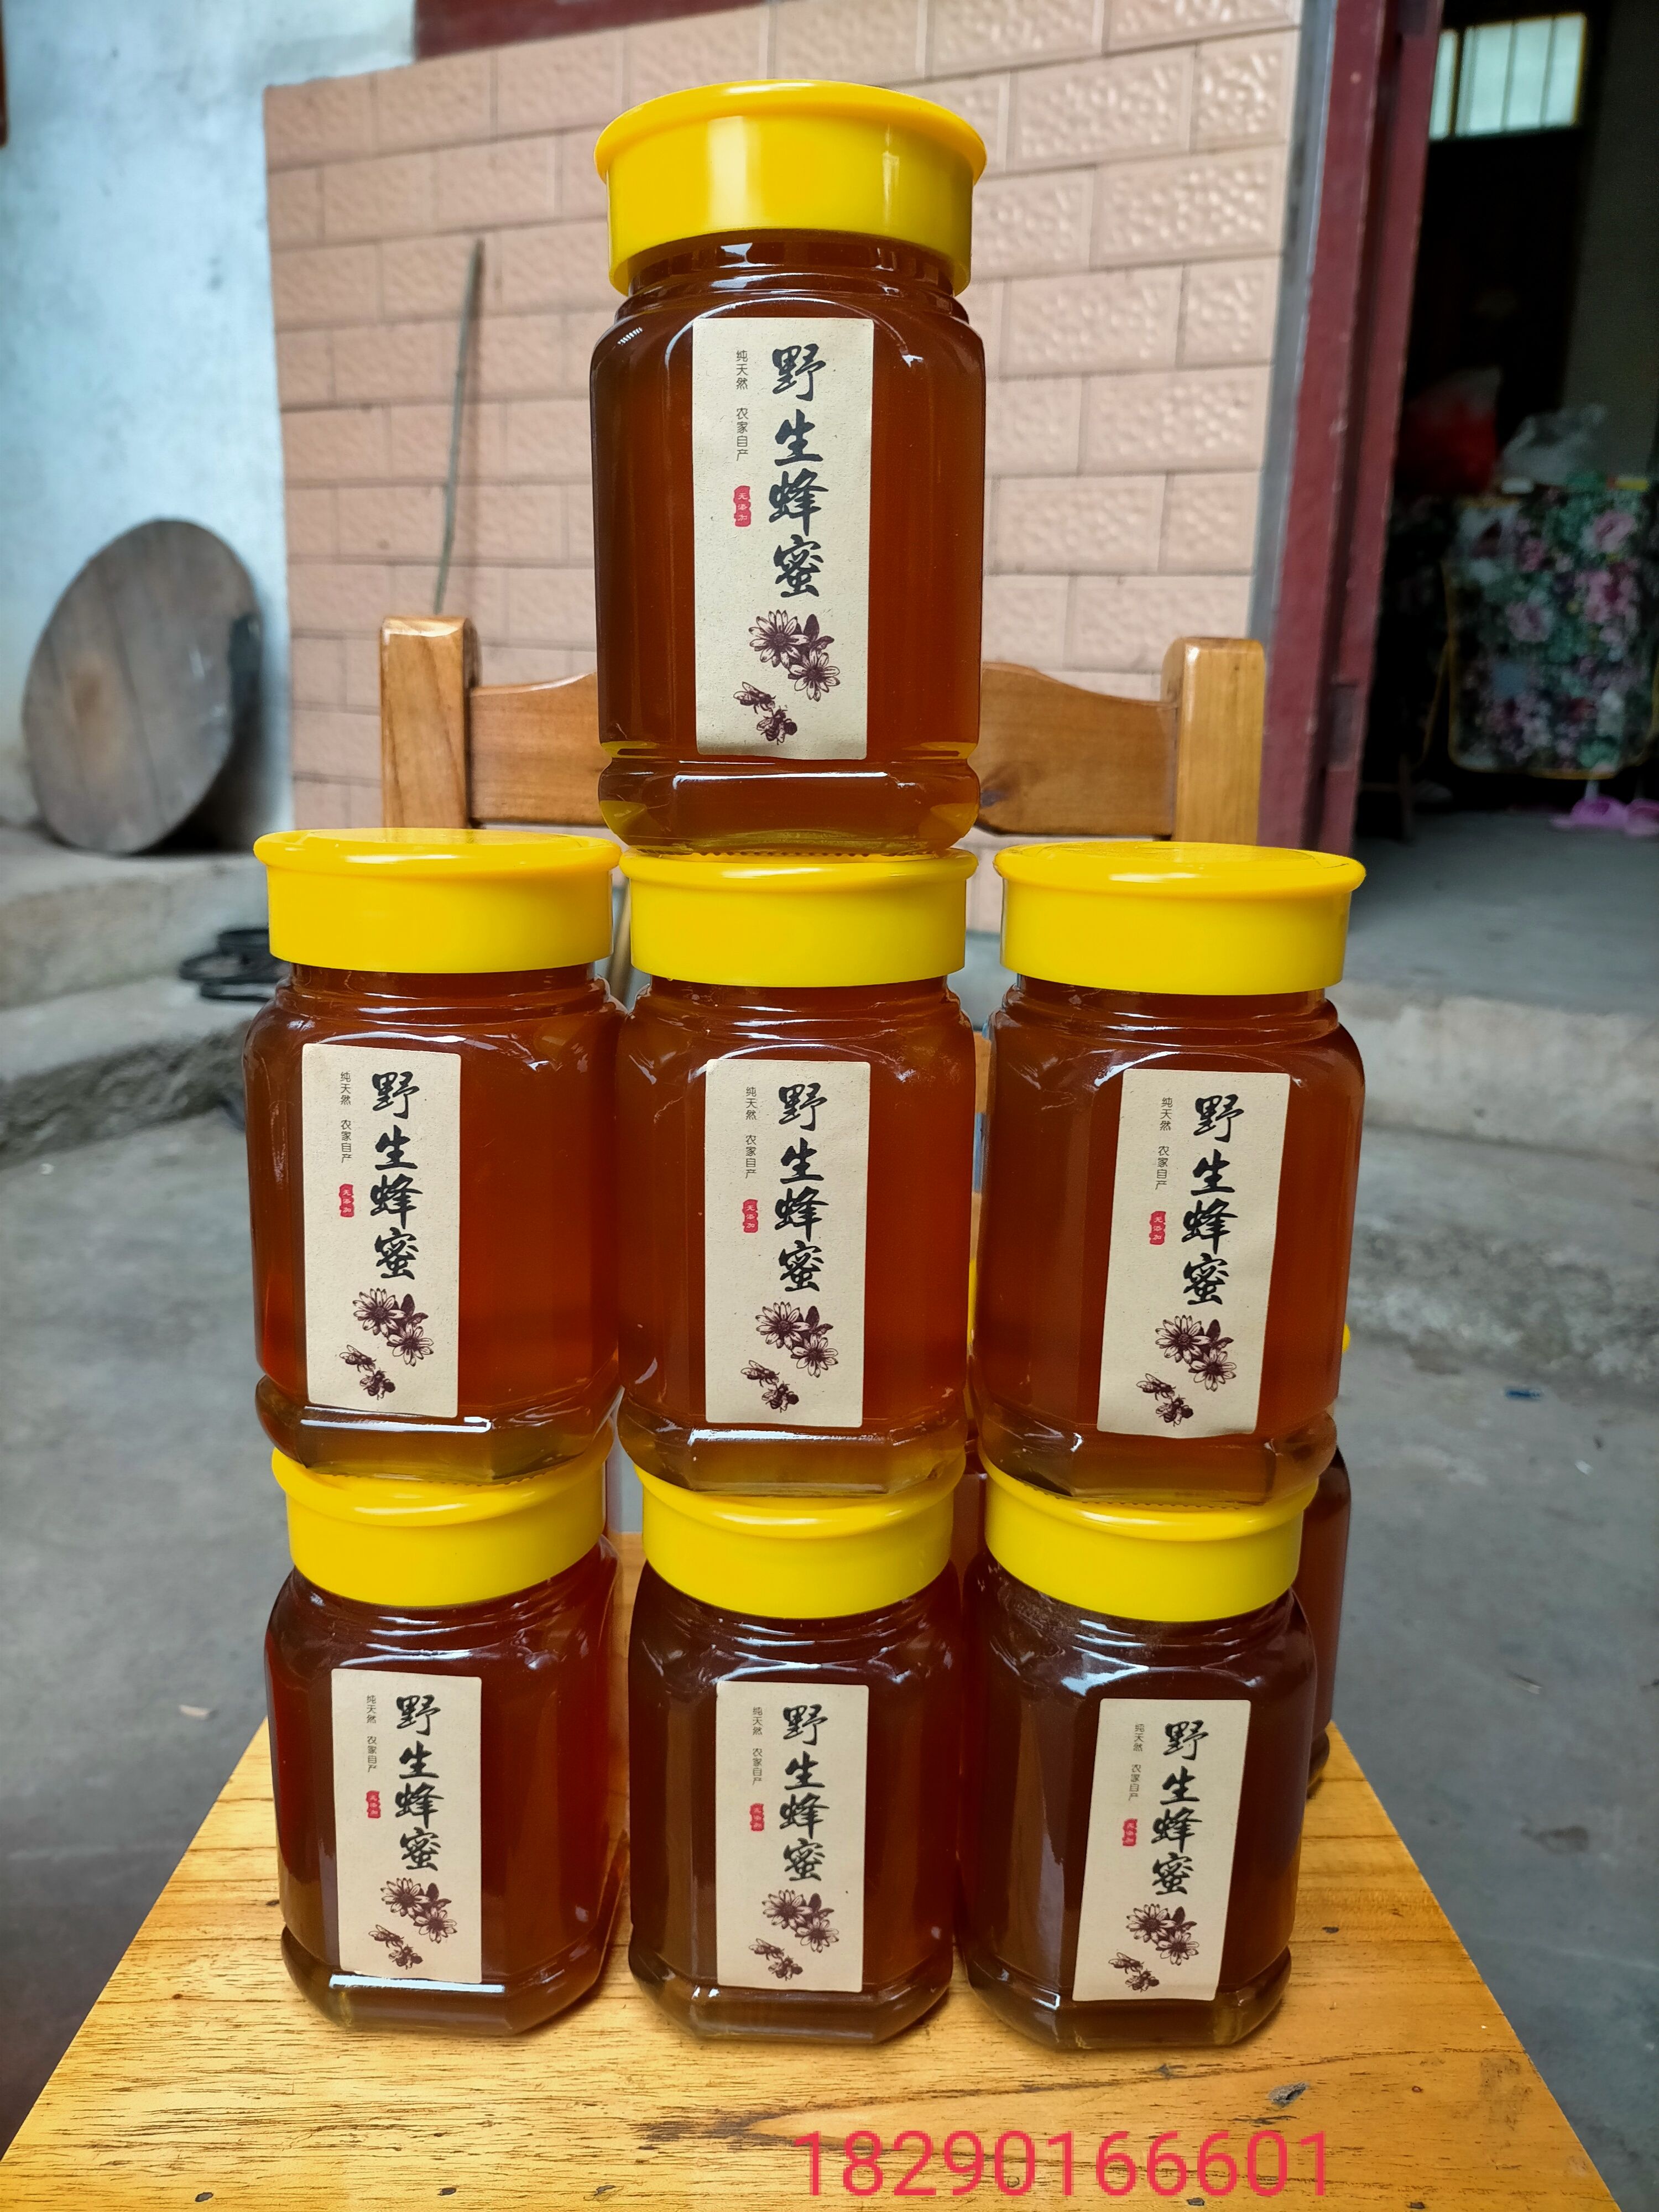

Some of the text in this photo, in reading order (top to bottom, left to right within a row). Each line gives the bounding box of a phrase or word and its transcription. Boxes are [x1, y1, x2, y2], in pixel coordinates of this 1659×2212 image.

[736, 350, 748, 461] 纯天然 农家自产
[769, 344, 828, 597] 野生蜂蜜
[340, 1071, 352, 1164] 纯天然 农家自产
[371, 1072, 422, 1280] 野生蜂蜜
[745, 1086, 757, 1179] 纯天然 农家自产
[775, 1083, 829, 1291] 野生蜂蜜
[1155, 1097, 1173, 1190] 纯天然 农家自产
[1182, 1094, 1244, 1305] 野生蜂蜜
[395, 1695, 444, 1871] 野生蜂蜜
[780, 1704, 829, 1881] 野生蜂蜜
[1151, 1720, 1208, 1895] 野生蜂蜜
